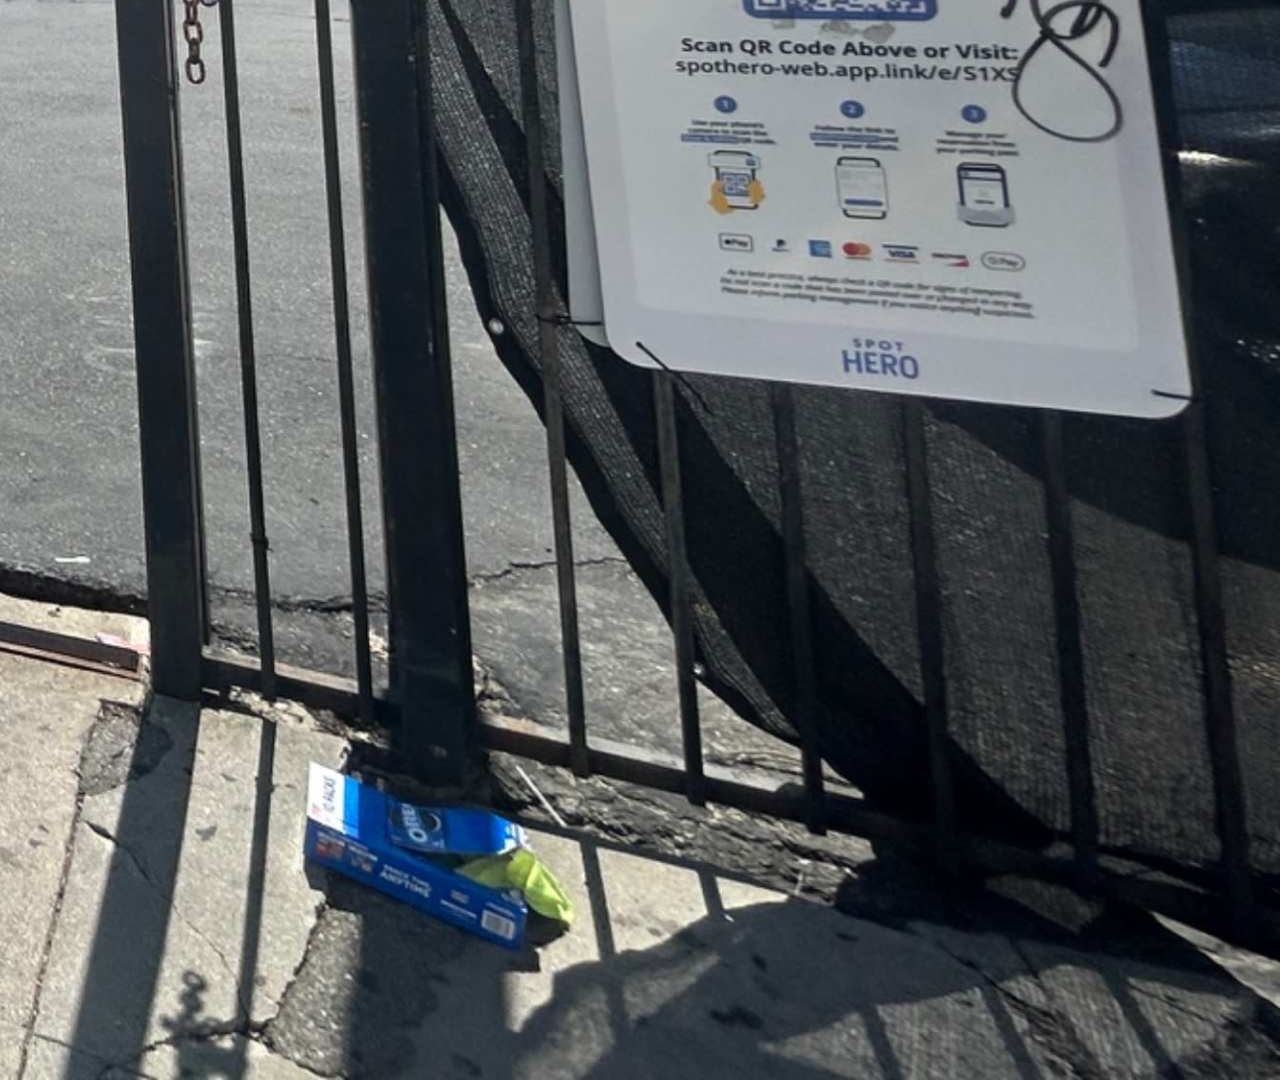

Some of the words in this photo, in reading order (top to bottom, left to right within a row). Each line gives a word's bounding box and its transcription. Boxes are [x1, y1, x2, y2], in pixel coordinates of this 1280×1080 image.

[681, 37, 733, 54] Scan
[739, 38, 773, 56] QR
[778, 39, 836, 57] Code
[841, 40, 918, 58] Above
[923, 45, 950, 59] or
[955, 43, 1019, 60] Visit:
[888, 249, 916, 259] VISA
[852, 338, 905, 352] SPOT
[841, 349, 920, 380] HERO
